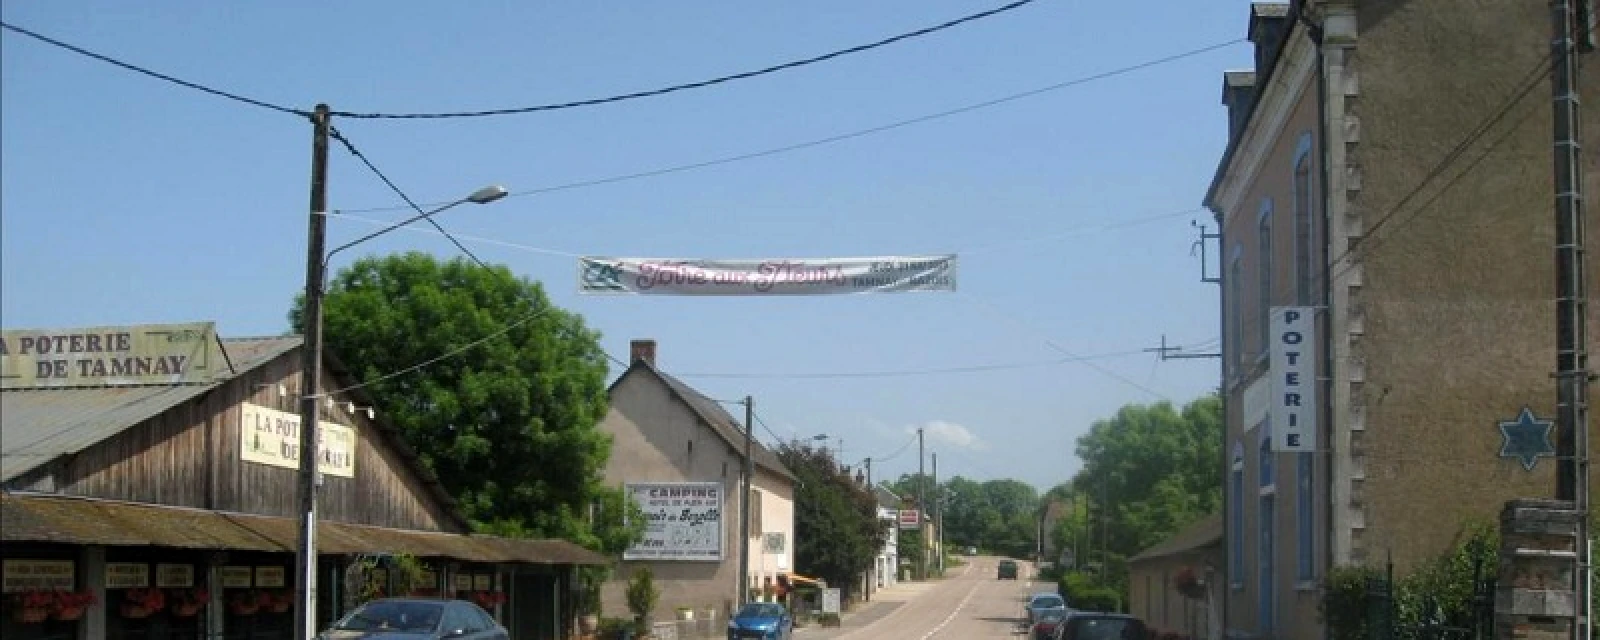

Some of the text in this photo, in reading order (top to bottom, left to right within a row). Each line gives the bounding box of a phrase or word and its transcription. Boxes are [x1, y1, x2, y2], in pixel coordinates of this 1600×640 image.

[20, 332, 131, 355] POTERIE
[36, 355, 187, 379] DE TAMNAY
[1281, 310, 1303, 448] POTERIE
[255, 413, 273, 433] LA
[283, 443, 298, 461] DE
[649, 488, 717, 499] CAMPING
